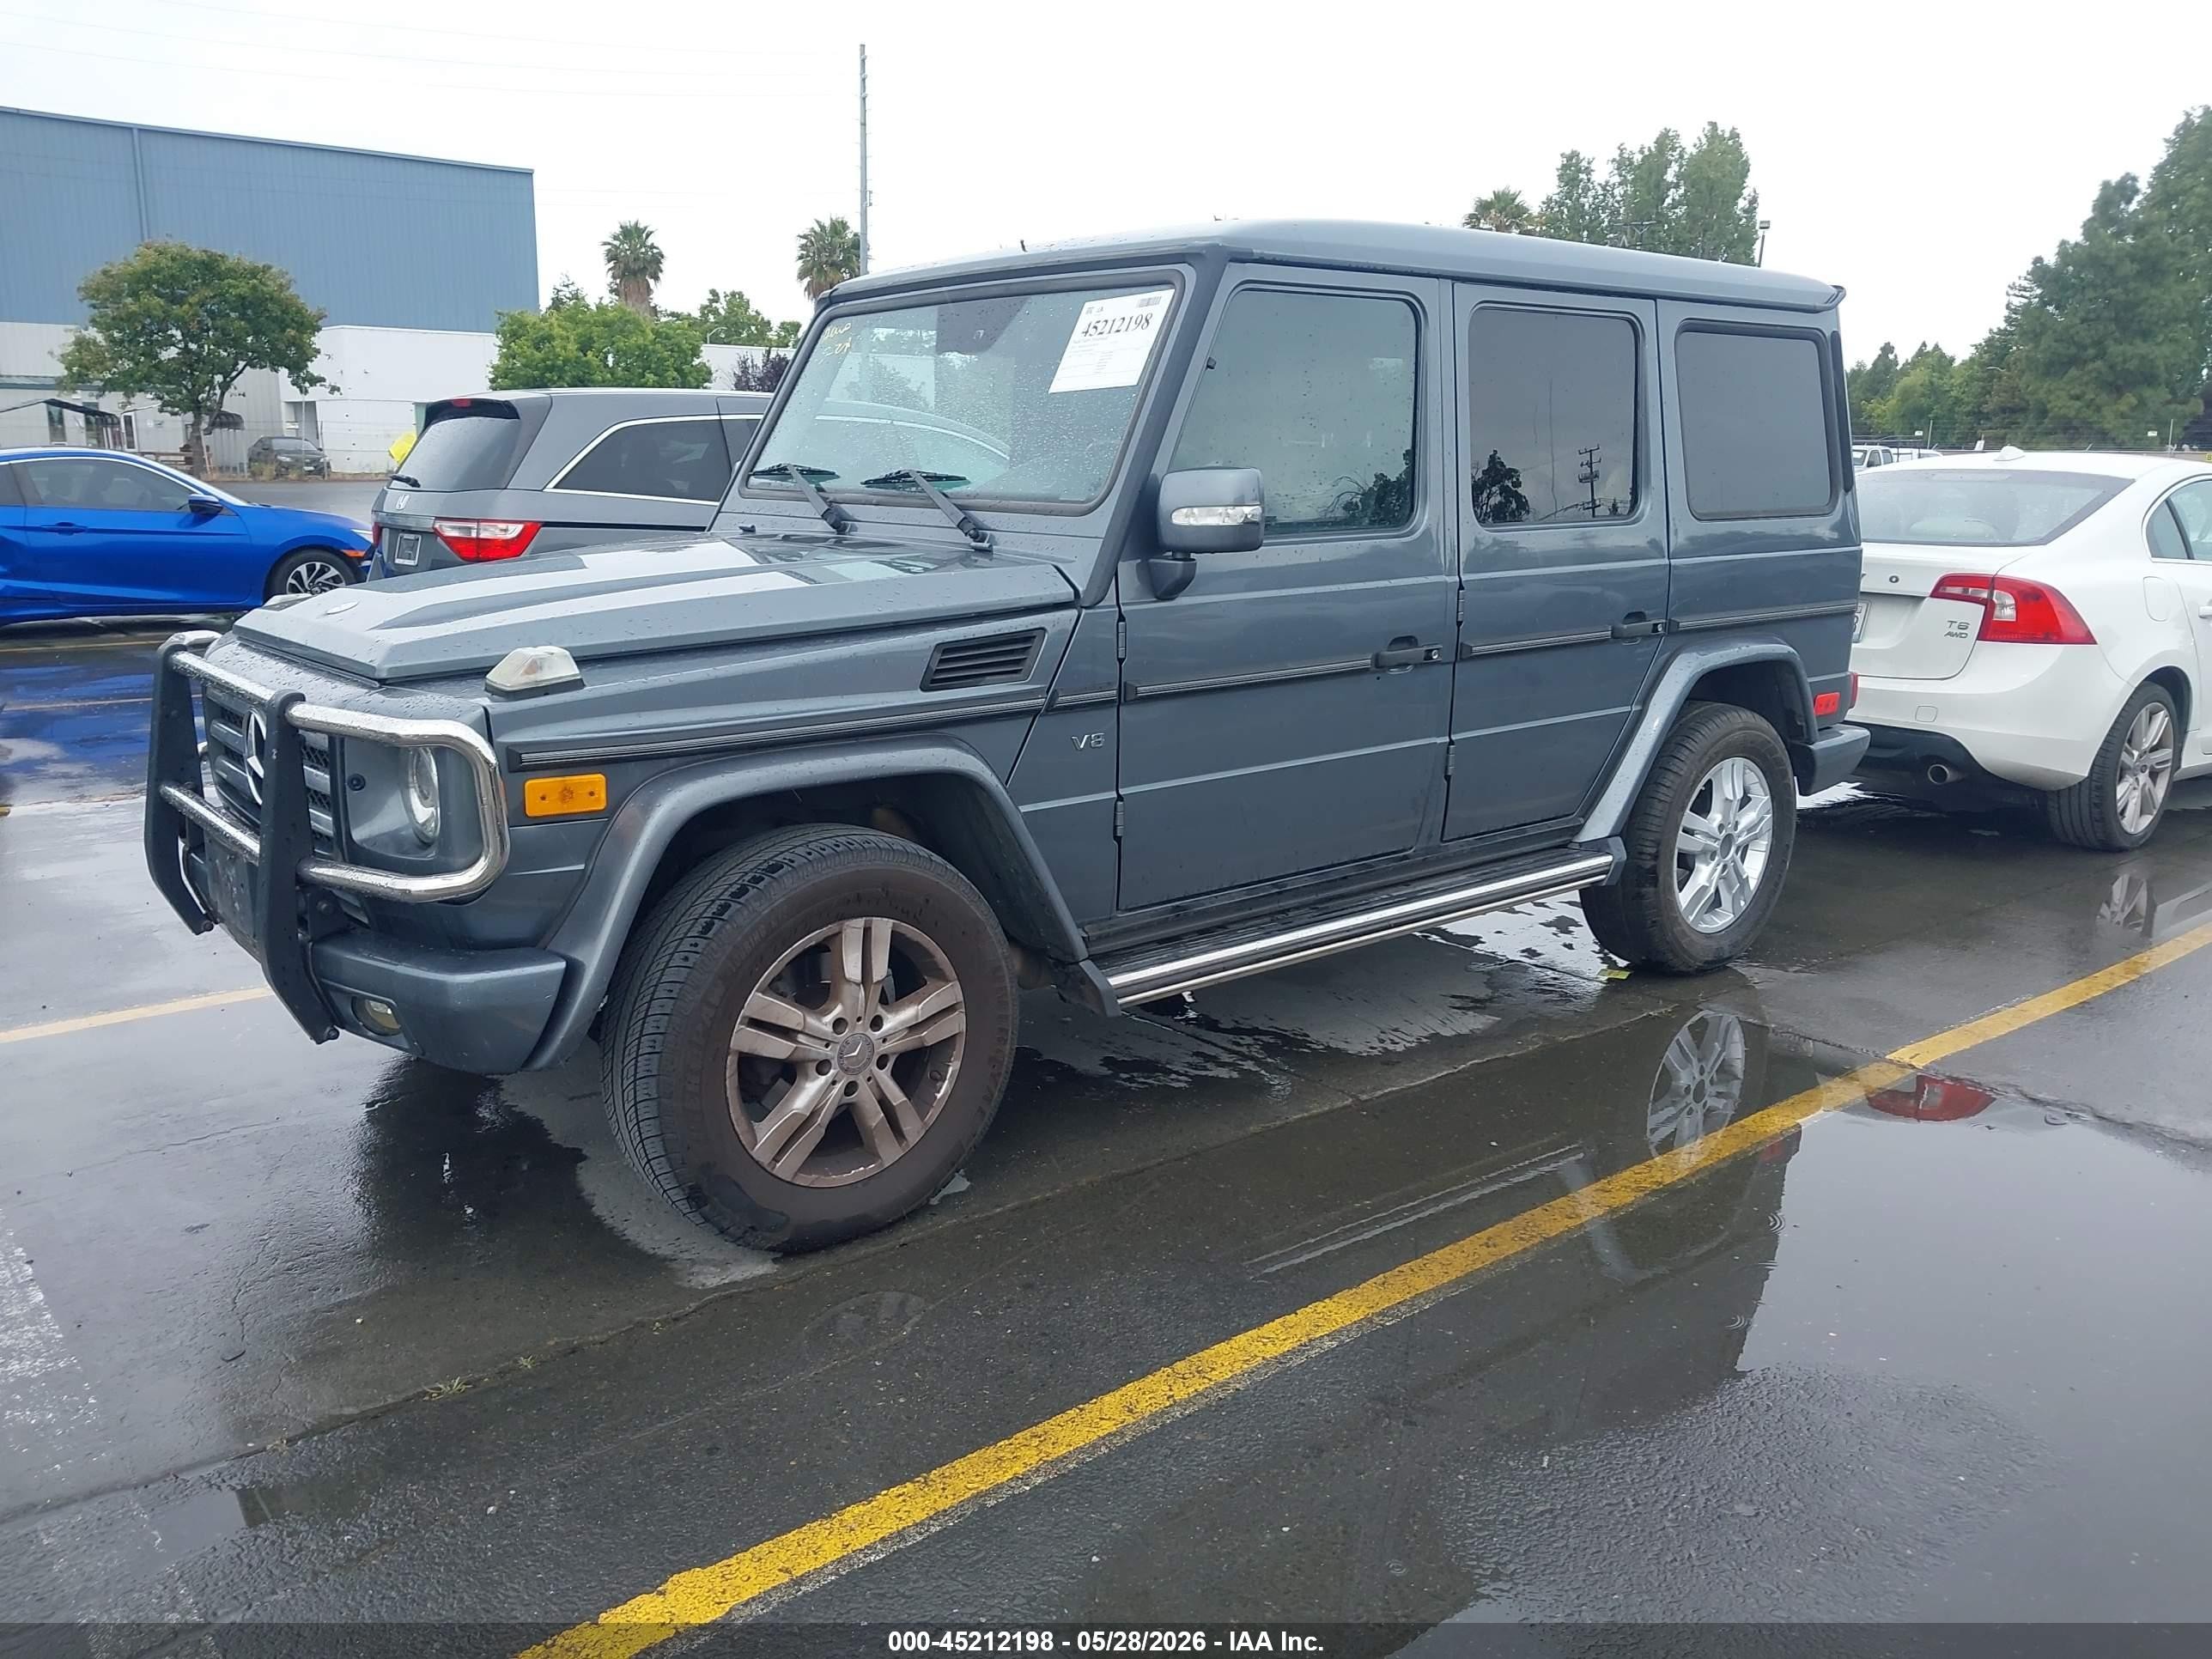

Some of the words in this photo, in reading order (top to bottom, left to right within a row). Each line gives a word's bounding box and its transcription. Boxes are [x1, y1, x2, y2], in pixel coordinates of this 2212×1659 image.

[1081, 313, 1152, 337] 45212198
[1947, 620, 1970, 630] T6
[1944, 630, 1968, 639] AWD
[1071, 732, 1105, 750] V8
